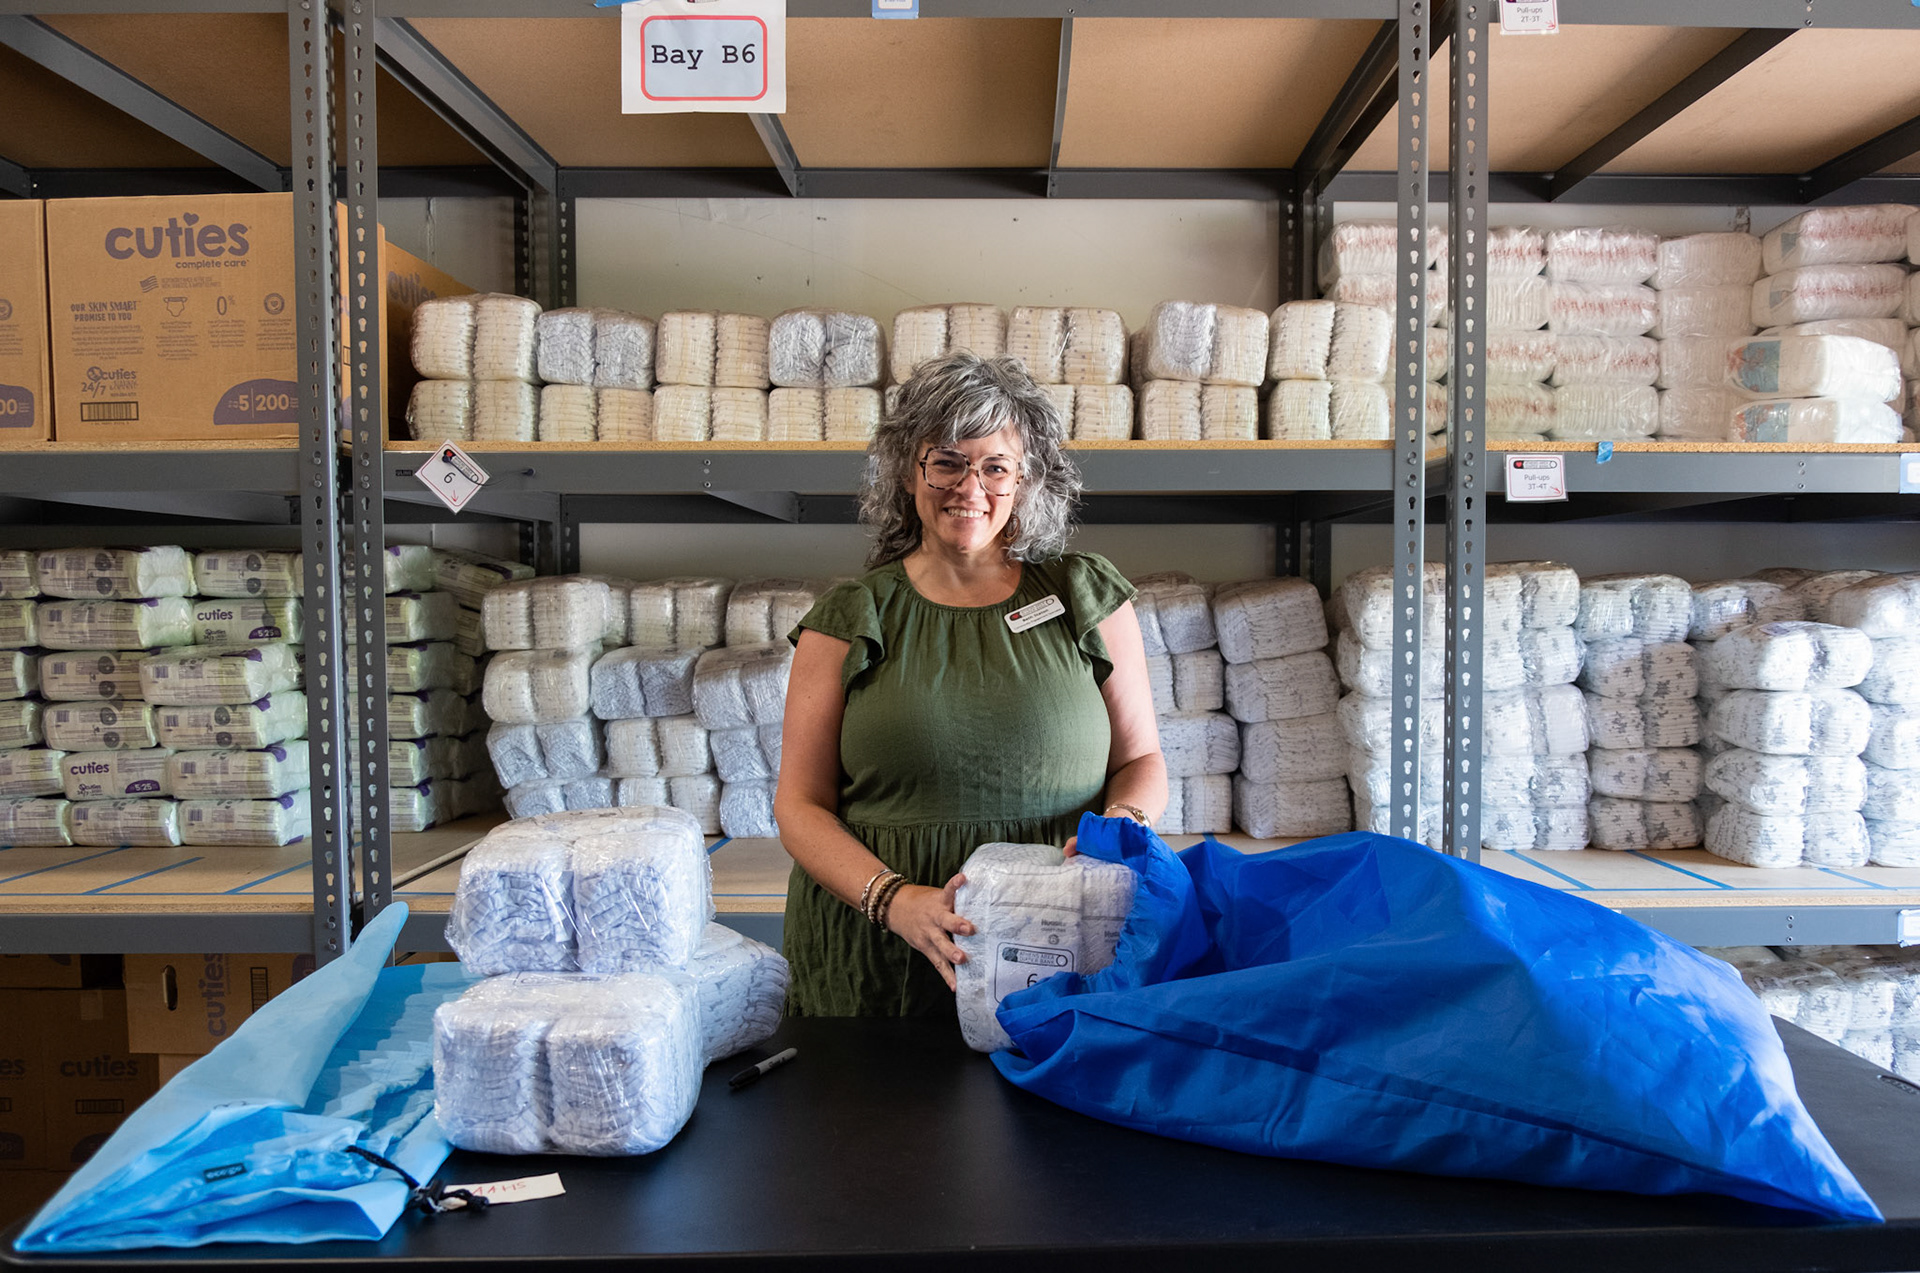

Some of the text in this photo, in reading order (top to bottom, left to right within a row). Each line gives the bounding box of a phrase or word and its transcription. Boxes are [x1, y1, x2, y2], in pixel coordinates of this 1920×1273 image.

[651, 44, 756, 70] Bay B6
[104, 212, 250, 260] cuties
[175, 259, 247, 270] complete care
[70, 301, 137, 312] OUR SKIN SMART
[74, 312, 132, 322] PROMISE TO YOU
[102, 368, 137, 380] cuties
[81, 381, 106, 399] 24/7
[239, 394, 250, 412] 5
[255, 393, 290, 411] 200
[443, 472, 456, 484] 6
[1524, 474, 1550, 482] Pull-ups
[197, 608, 233, 621] cuties
[70, 762, 110, 775] cuties
[60, 1055, 139, 1077] cuties
